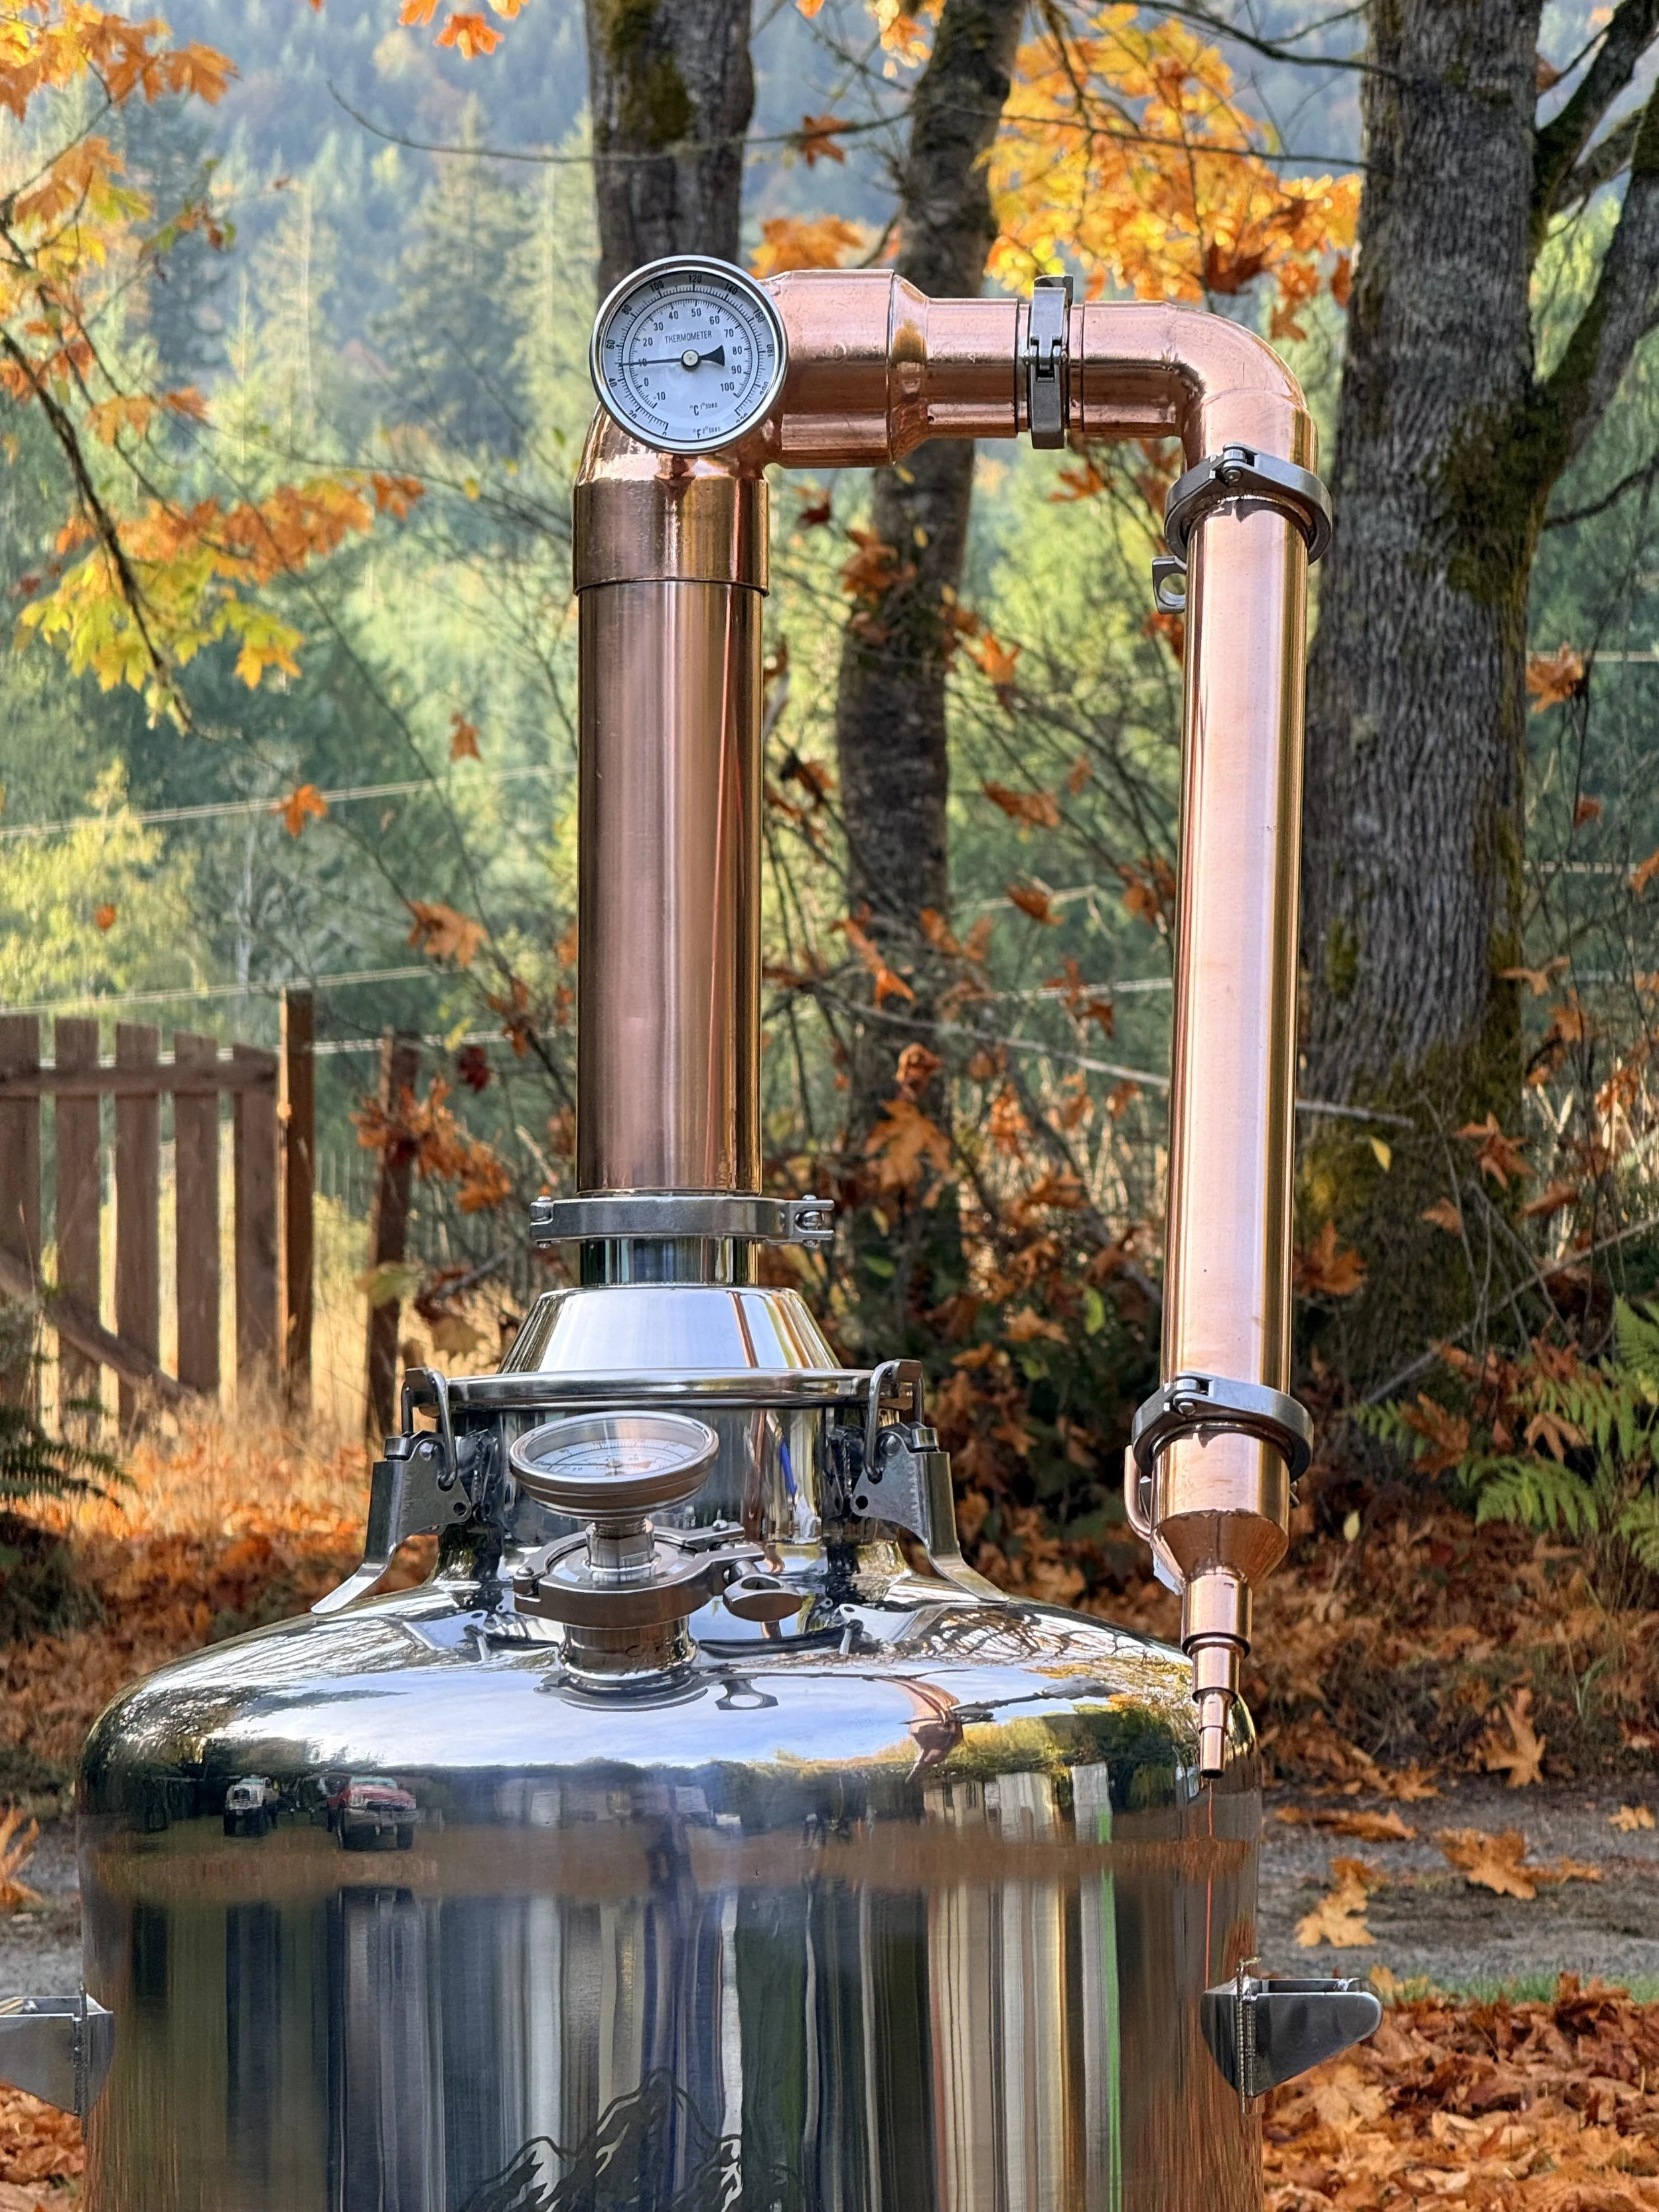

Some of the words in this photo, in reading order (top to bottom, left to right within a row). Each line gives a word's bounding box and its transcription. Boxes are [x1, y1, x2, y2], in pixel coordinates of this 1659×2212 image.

[650, 280, 664, 291] 100
[724, 283, 739, 295] 140
[621, 304, 632, 316] 80
[691, 308, 701, 317] 50
[668, 311, 679, 320] 40
[709, 315, 720, 325] 60
[753, 309, 766, 323] 160
[653, 322, 664, 331] 30
[664, 331, 712, 344] THERMOMETER
[724, 329, 734, 338] 70
[606, 339, 616, 350] 60
[642, 337, 653, 347] 20
[733, 346, 743, 354] 80
[766, 344, 775, 358] 180
[638, 358, 648, 367] 10
[731, 365, 742, 374] 90
[608, 378, 617, 388] 40
[644, 377, 649, 387] 0
[721, 382, 735, 392] 100
[654, 392, 666, 401] -10
[689, 405, 699, 416] °C
[693, 429, 701, 439] °F
